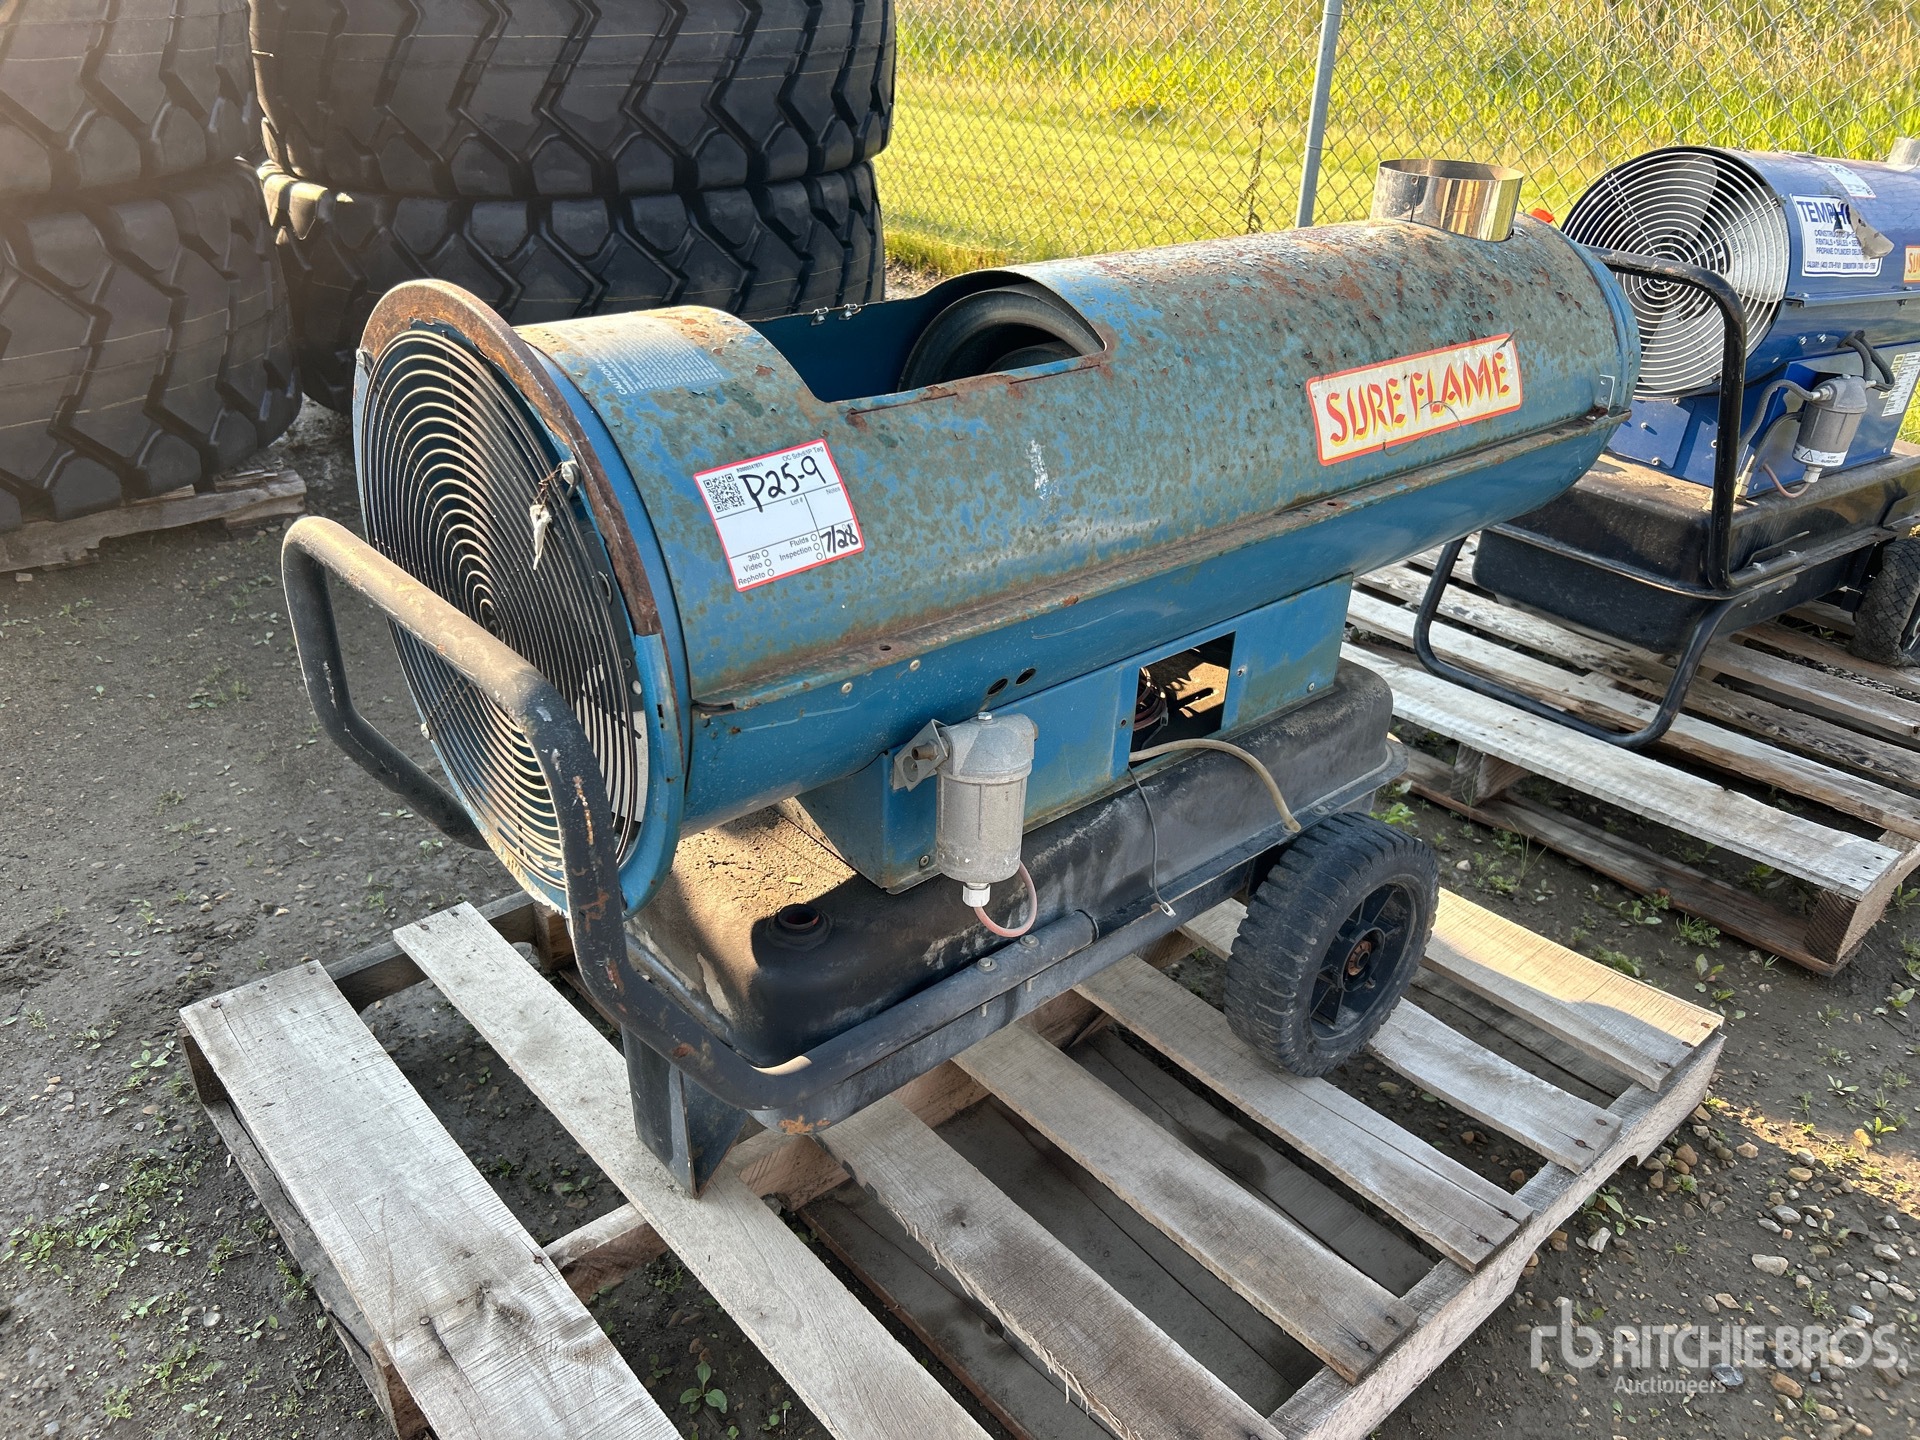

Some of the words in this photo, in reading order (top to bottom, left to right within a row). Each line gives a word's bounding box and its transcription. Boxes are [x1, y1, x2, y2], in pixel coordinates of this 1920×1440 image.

[813, 445, 824, 454] Tag
[825, 486, 841, 495] Notes
[790, 498, 799, 506] Lot
[789, 536, 809, 548] Fluids
[820, 525, 859, 554] 7/28
[747, 552, 760, 562] 360
[779, 546, 812, 561] Inspection
[743, 562, 763, 573] Video
[738, 572, 766, 586] Rephoto
